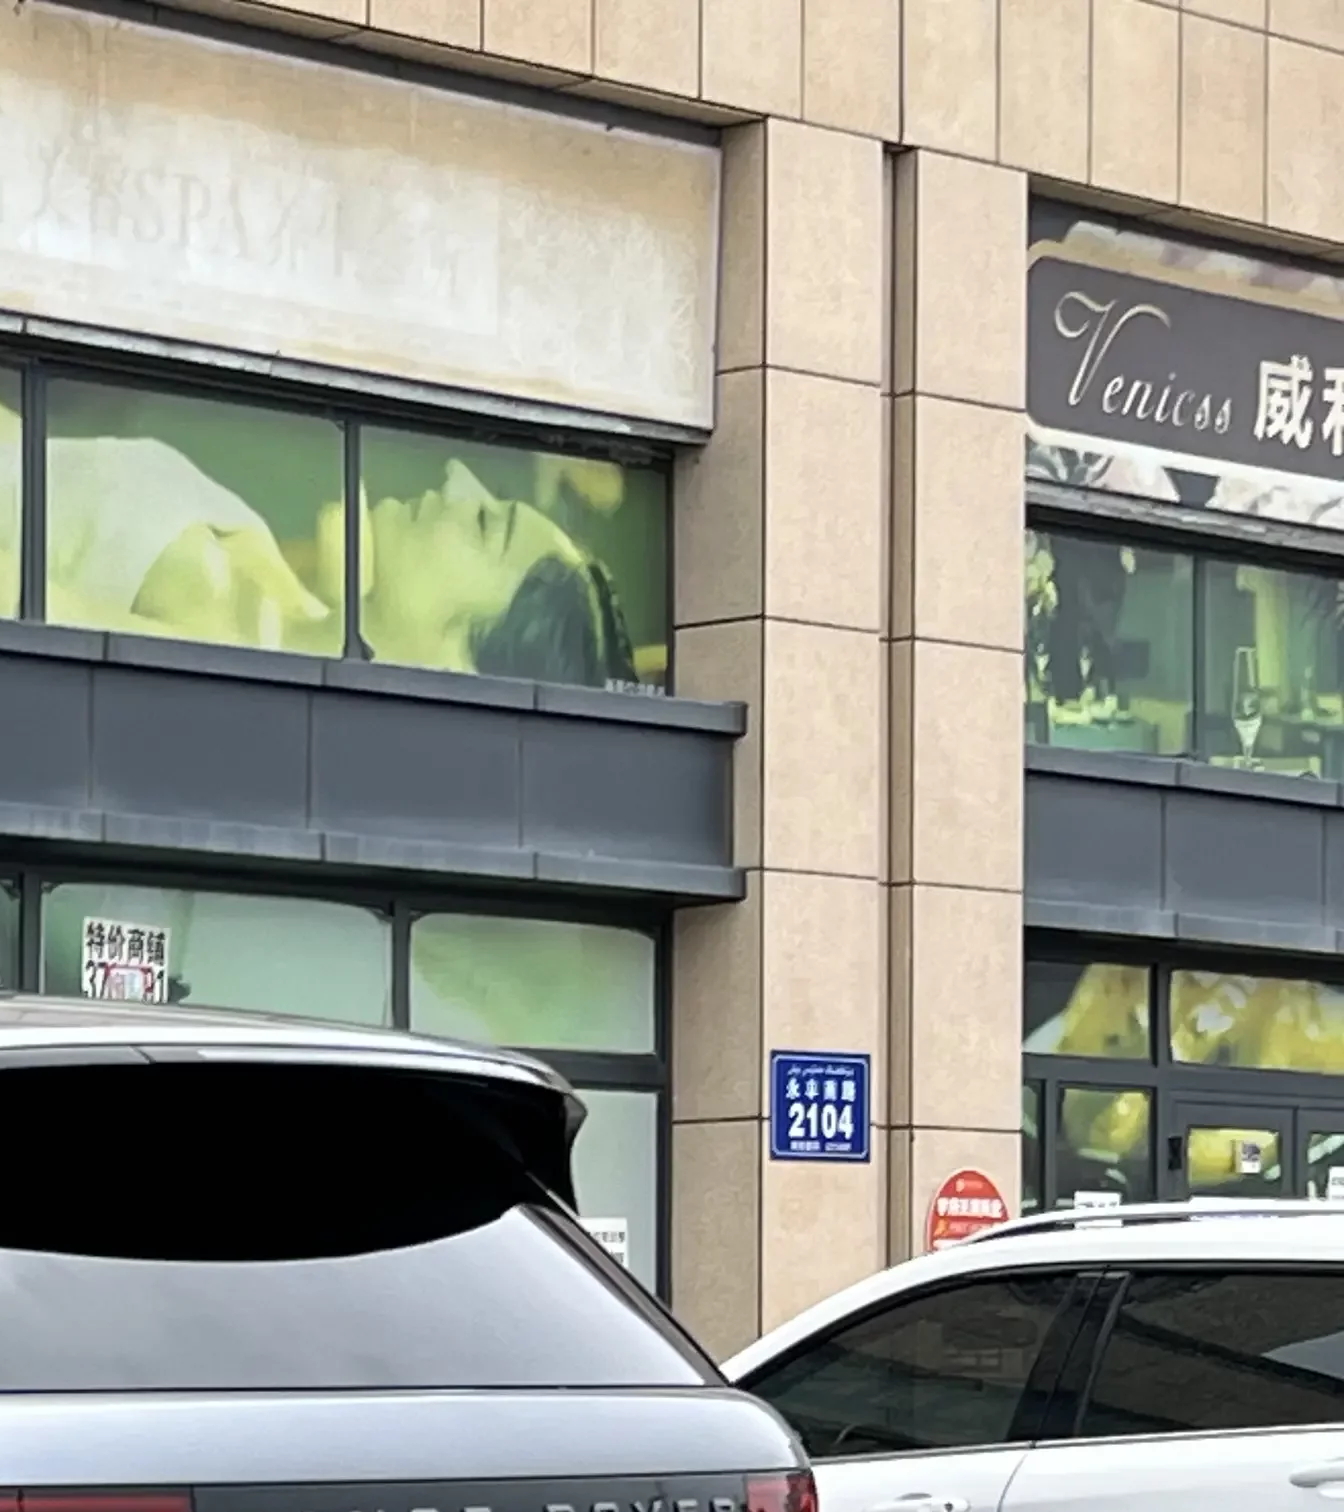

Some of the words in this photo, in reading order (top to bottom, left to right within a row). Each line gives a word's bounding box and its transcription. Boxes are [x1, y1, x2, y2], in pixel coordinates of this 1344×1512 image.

[86, 921, 166, 966] 特价商铺
[788, 1102, 854, 1140] 2104
